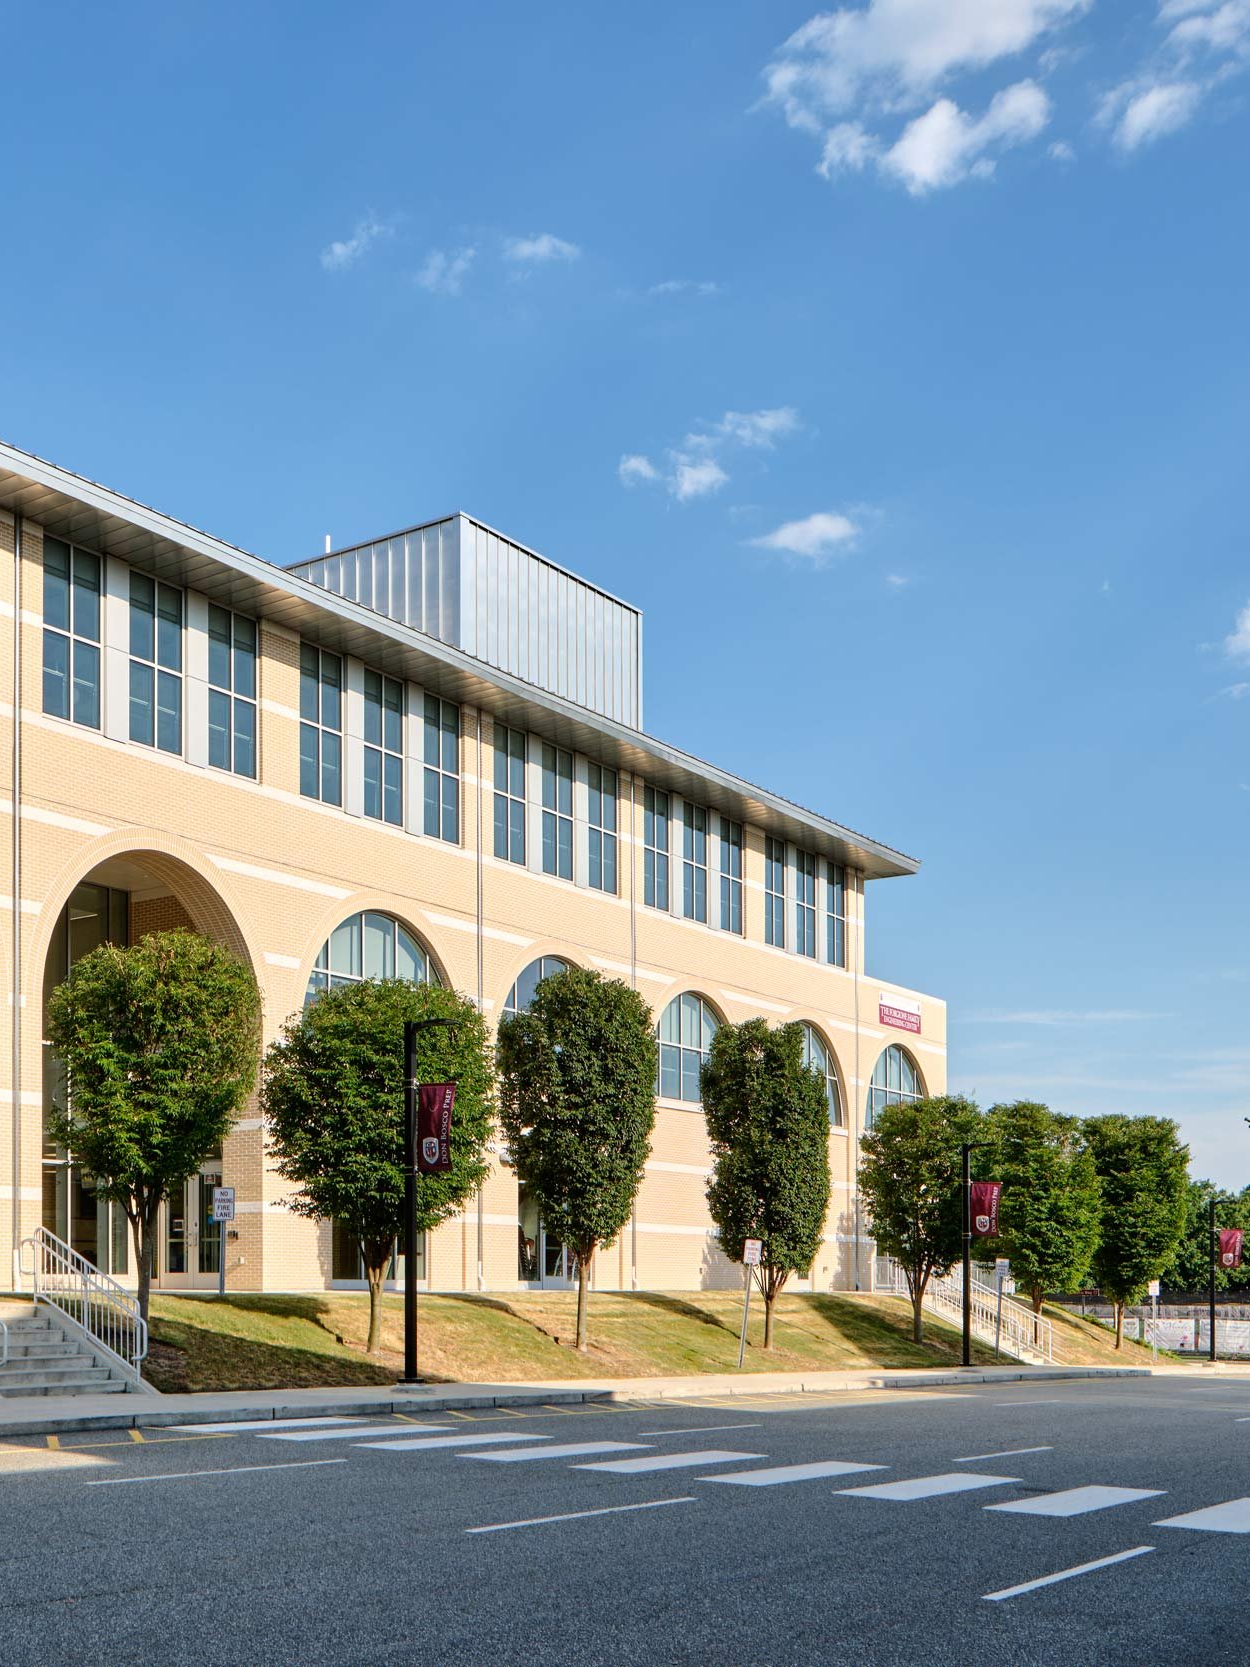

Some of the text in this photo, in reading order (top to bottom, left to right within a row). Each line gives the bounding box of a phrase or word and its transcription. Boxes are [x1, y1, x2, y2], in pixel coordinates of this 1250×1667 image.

[440, 1089, 452, 1164] DON BOSCO PREP
